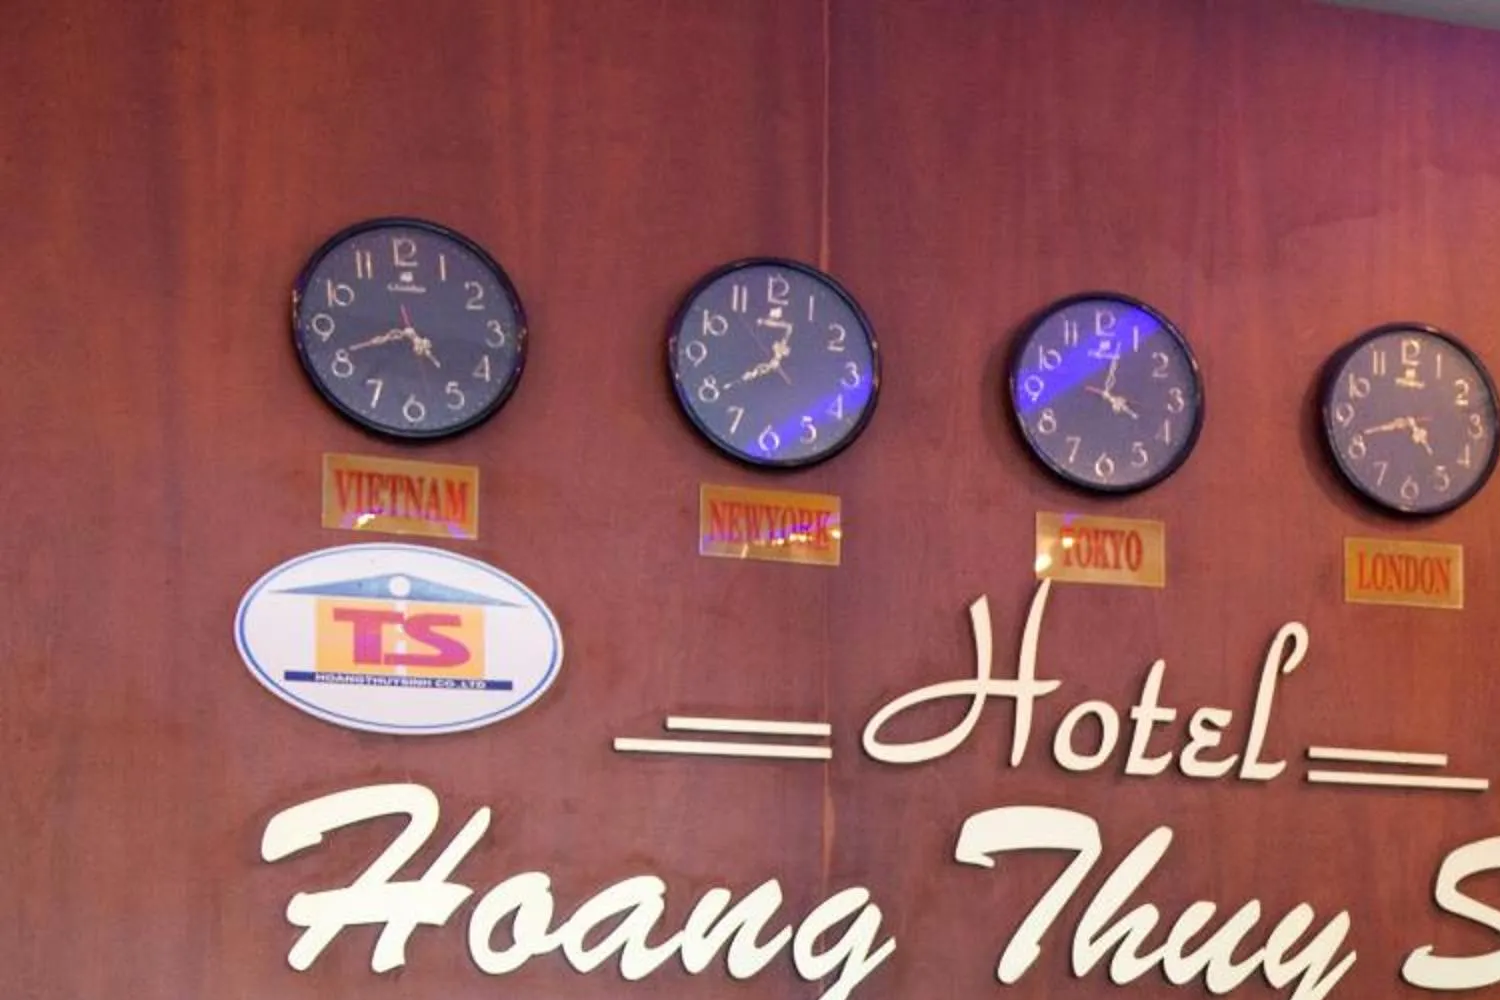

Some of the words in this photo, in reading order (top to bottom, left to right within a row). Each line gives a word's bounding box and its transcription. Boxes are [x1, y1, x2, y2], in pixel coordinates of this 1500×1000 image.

[356, 250, 371, 279] 11
[393, 237, 418, 267] 12
[327, 279, 355, 307] 10
[465, 281, 484, 310] 2
[732, 285, 747, 313] 11
[767, 274, 789, 305] 12
[312, 314, 335, 342] 9
[486, 320, 505, 348] 3
[703, 309, 728, 336] 10
[1064, 320, 1077, 345] 11
[1095, 310, 1116, 336] 12
[827, 324, 845, 352] 2
[332, 349, 353, 378] 8
[686, 340, 707, 367] 9
[1039, 345, 1061, 370] 10
[1152, 351, 1168, 377] 2
[1373, 351, 1385, 376] 11
[1401, 340, 1420, 365] 12
[473, 355, 491, 382] 4
[841, 362, 860, 388] 3
[366, 379, 383, 408] 7
[445, 381, 465, 410] 5
[698, 375, 719, 402] 8
[1025, 376, 1044, 402] 9
[1349, 373, 1370, 397] 10
[1455, 379, 1469, 405] 2
[403, 395, 425, 422] 6
[827, 393, 842, 419] 4
[1168, 387, 1184, 413] 3
[727, 406, 744, 434] 7
[1037, 408, 1056, 433] 8
[1336, 403, 1354, 427] 9
[1468, 413, 1483, 439] 3
[759, 425, 779, 451] 6
[800, 416, 816, 443] 5
[1156, 420, 1170, 444] 4
[1066, 436, 1081, 463] 7
[1131, 442, 1147, 466] 5
[1349, 434, 1366, 459] 8
[1457, 444, 1470, 468] 4
[1095, 453, 1114, 477] 6
[1373, 461, 1388, 486] 7
[1434, 465, 1449, 491] 5
[335, 469, 469, 524] VIETNAM
[1401, 476, 1419, 499] 6
[709, 500, 831, 550] NEWYORK
[1060, 526, 1143, 572] TOKYO
[1358, 547, 1451, 595] LONDON
[861, 578, 1309, 780] Hotel
